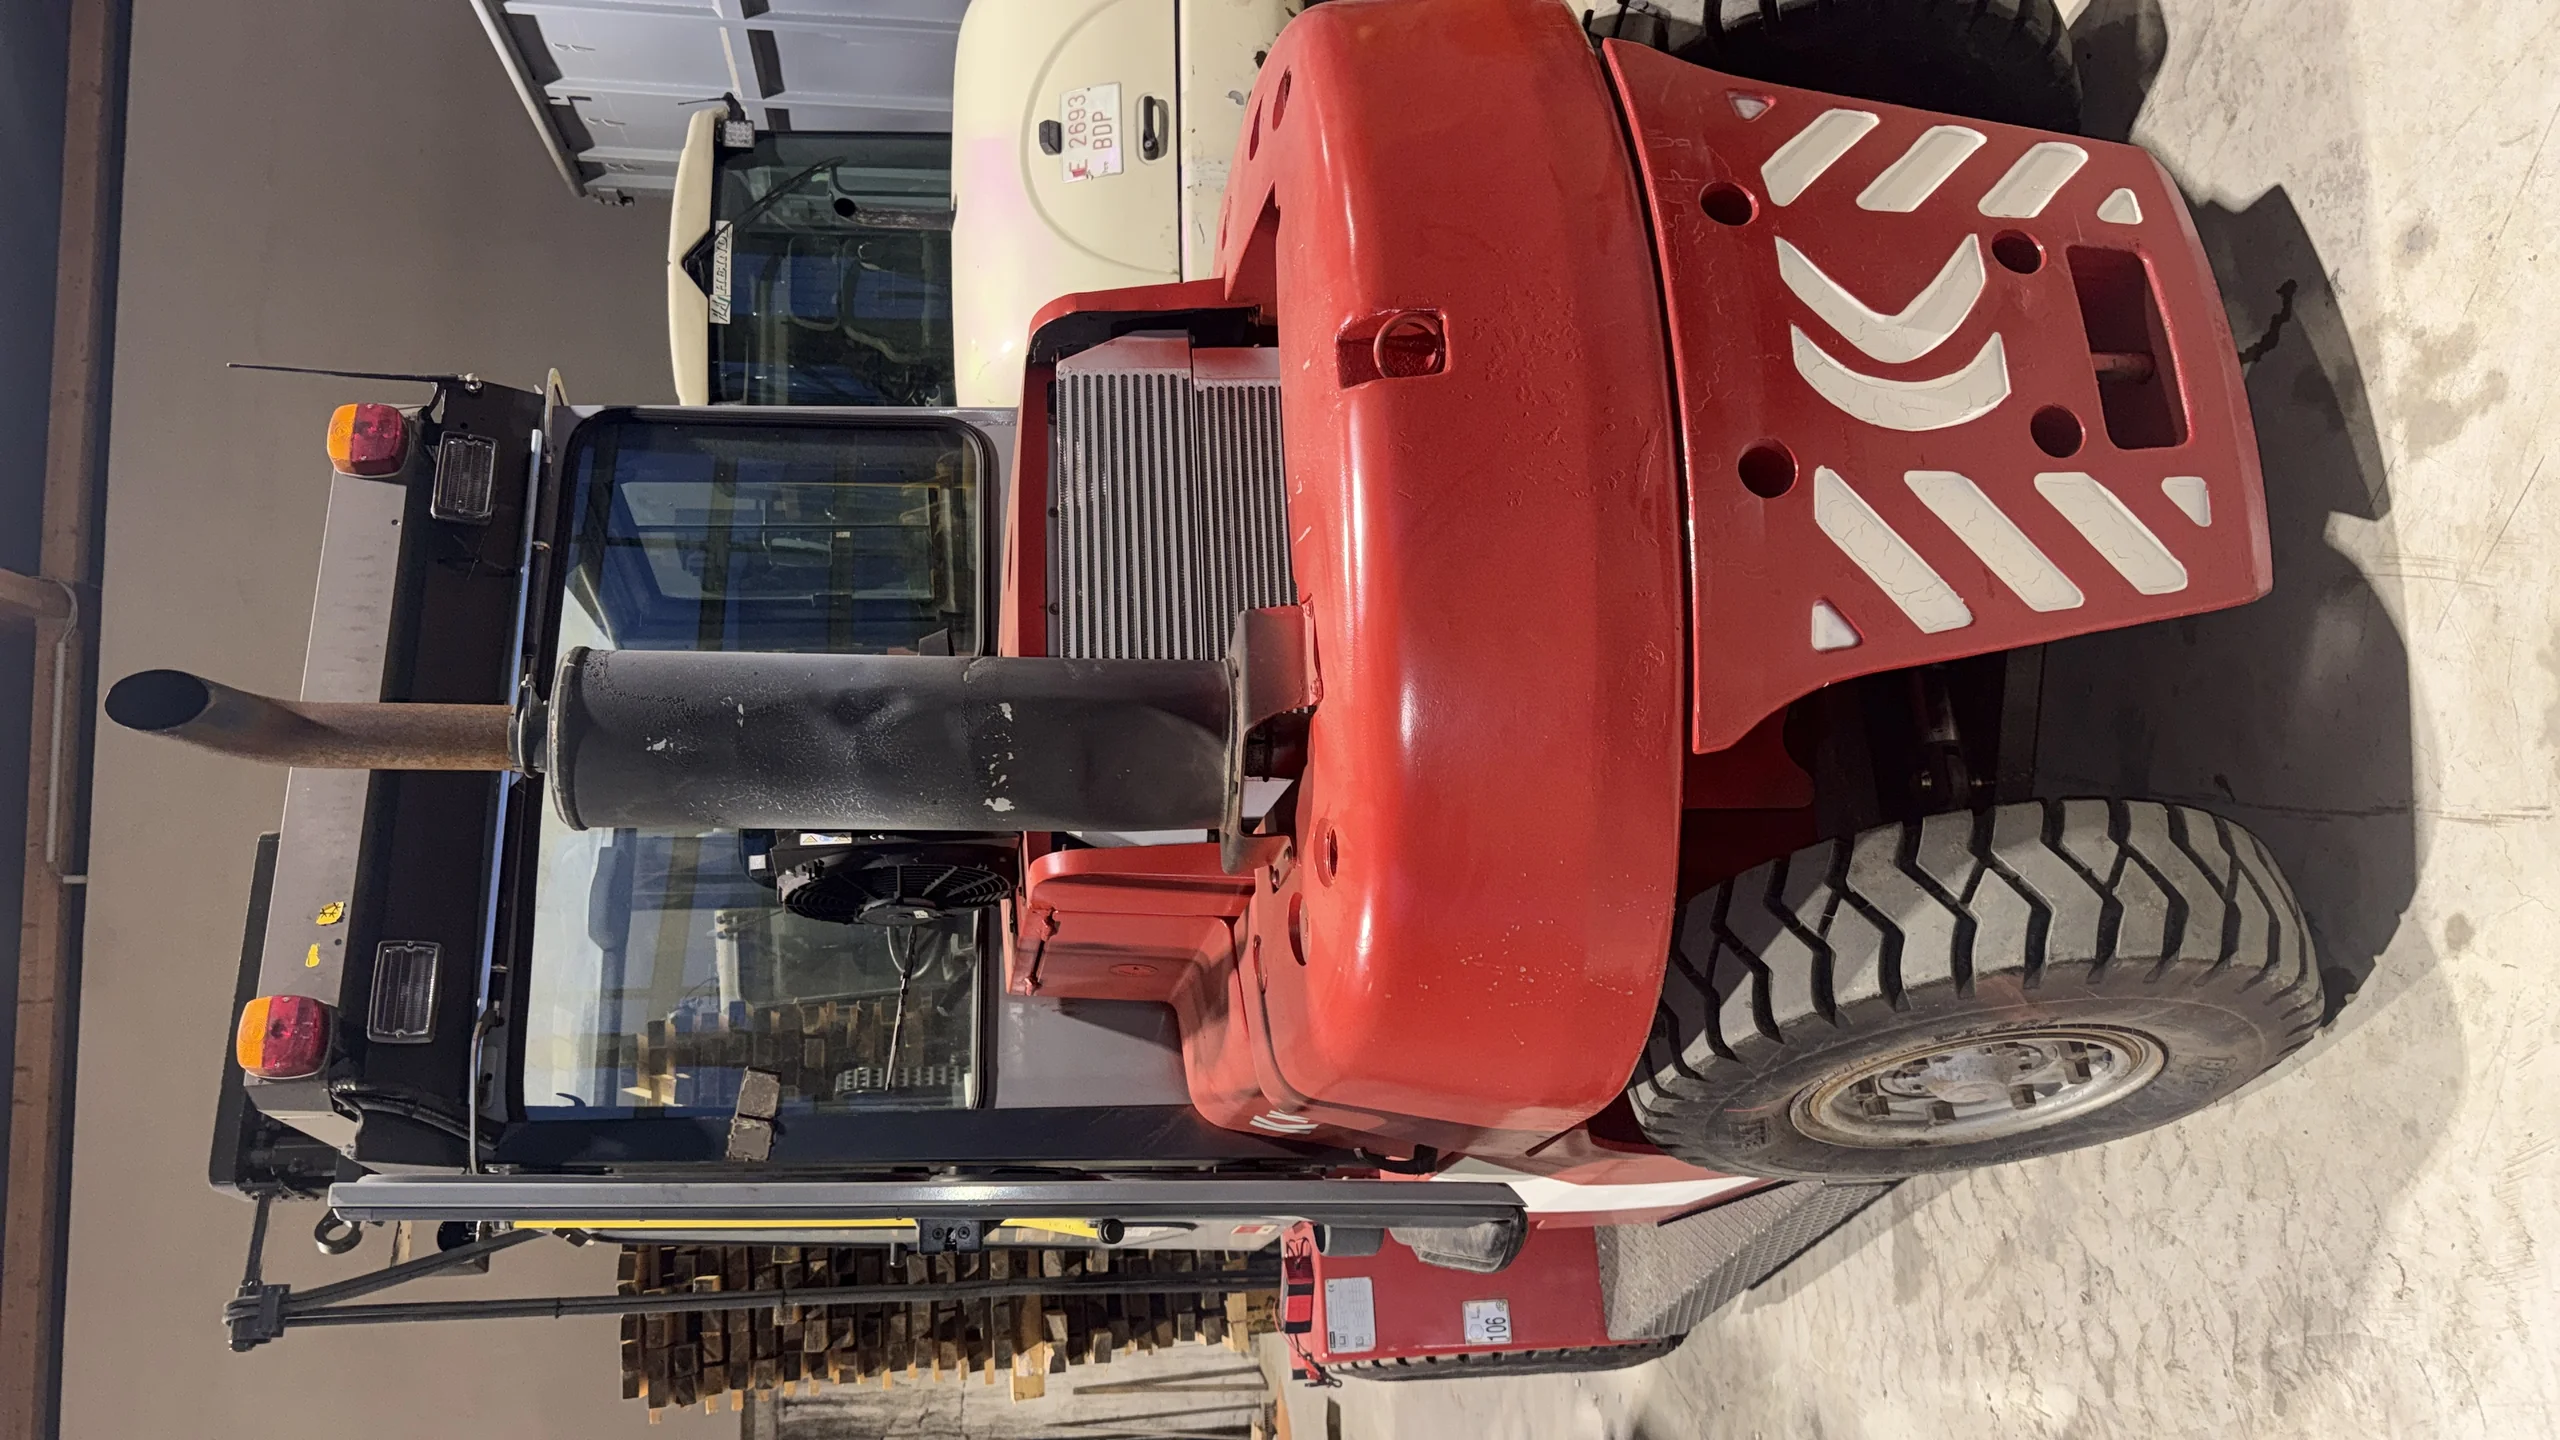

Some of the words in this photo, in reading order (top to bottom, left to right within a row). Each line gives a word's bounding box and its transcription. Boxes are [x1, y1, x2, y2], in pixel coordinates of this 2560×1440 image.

[1067, 94, 1087, 149] 2693
[1091, 111, 1113, 151] BDP
[1485, 1317, 1507, 1341] 106
